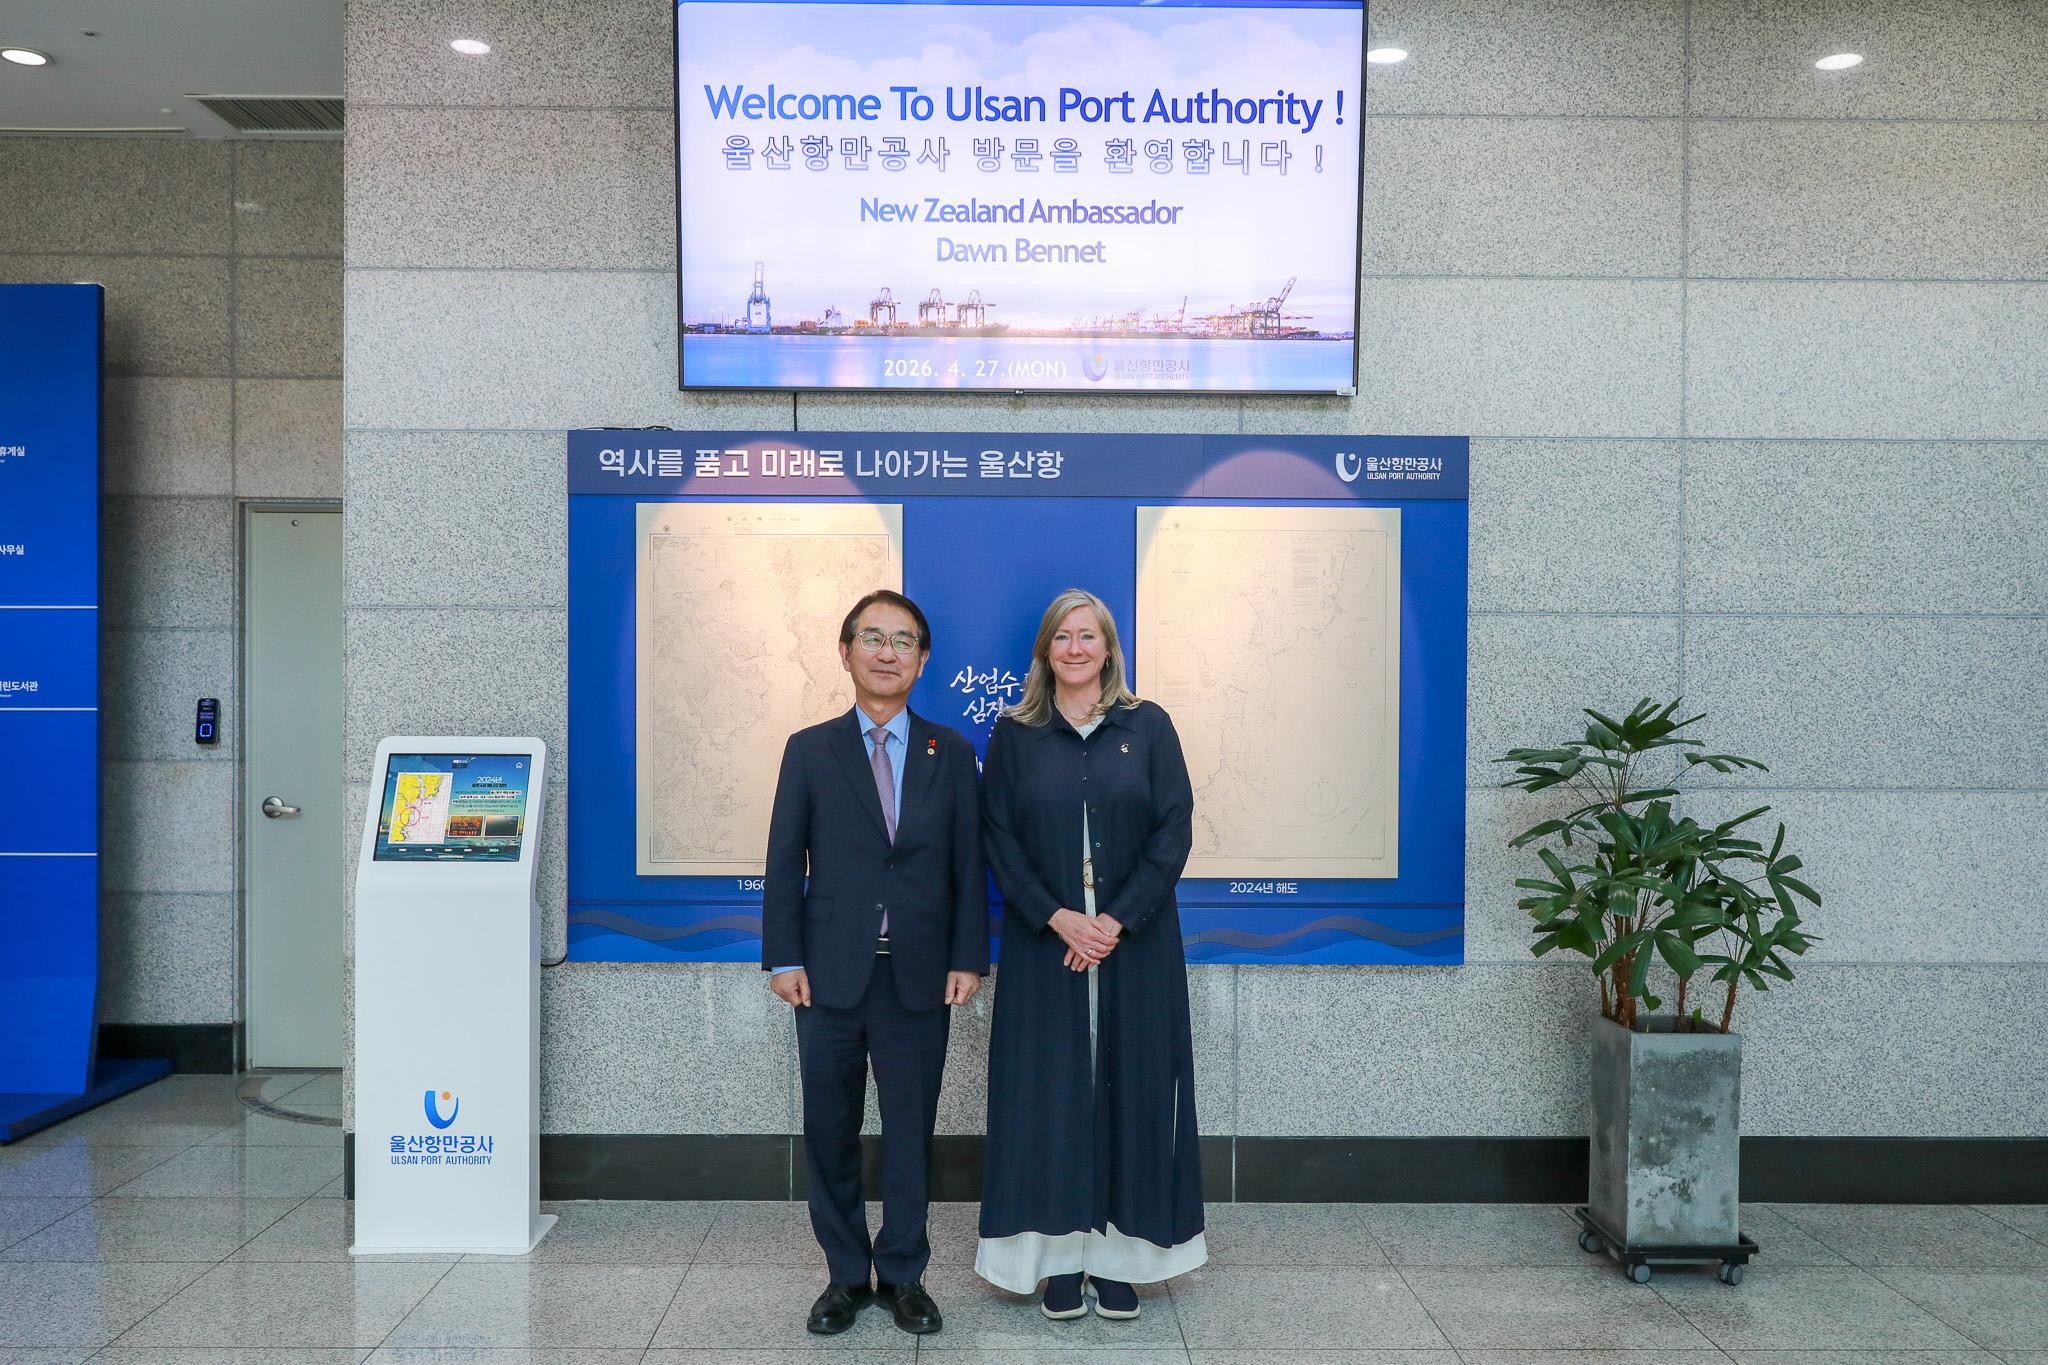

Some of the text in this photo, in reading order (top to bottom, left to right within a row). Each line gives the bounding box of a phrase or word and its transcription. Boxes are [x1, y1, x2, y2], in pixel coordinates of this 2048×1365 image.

[704, 84, 1344, 133] Welcome To Ulsan Port Authority !
[722, 135, 1323, 175] 울산항만공사 방문을 환영합니다 !
[860, 197, 1183, 224] New Zealand Ambassador
[936, 237, 1106, 263] Dawn Bennet
[884, 360, 939, 377] 2026.
[948, 360, 965, 377] 4.
[599, 448, 1064, 479] 역사를 품고 미래로 나아가는 울산항
[1366, 456, 1442, 471] 울산항만공사
[1367, 472, 1387, 480] ULSAN
[1388, 472, 1405, 480] PORT
[1230, 882, 1298, 894] 2024년 해도
[390, 1135, 494, 1153] 울산항만공사
[391, 1155, 492, 1165] ULSAN PORT AUTHORITY
